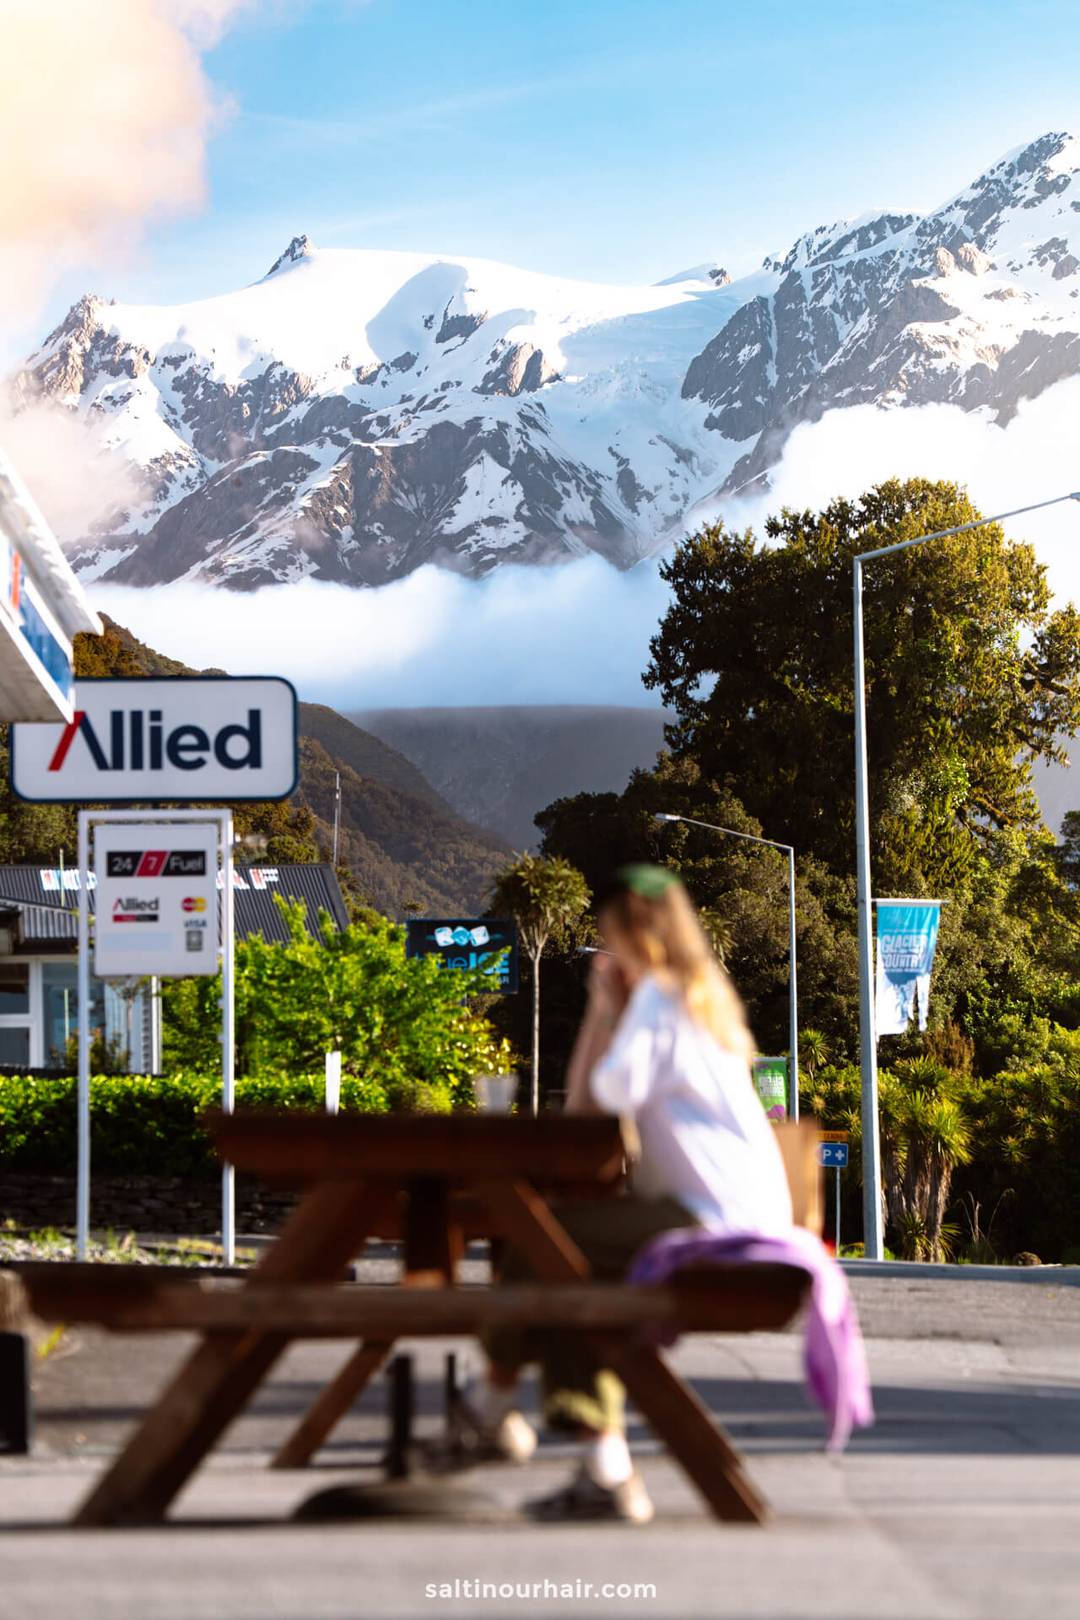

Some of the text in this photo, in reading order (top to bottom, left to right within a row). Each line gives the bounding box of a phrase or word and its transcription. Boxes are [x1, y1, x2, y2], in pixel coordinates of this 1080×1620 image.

[48, 709, 262, 771] Allied
[112, 856, 204, 871] 24 7 Fuel
[112, 897, 160, 911] Allied
[882, 935, 927, 953] GLACIER
